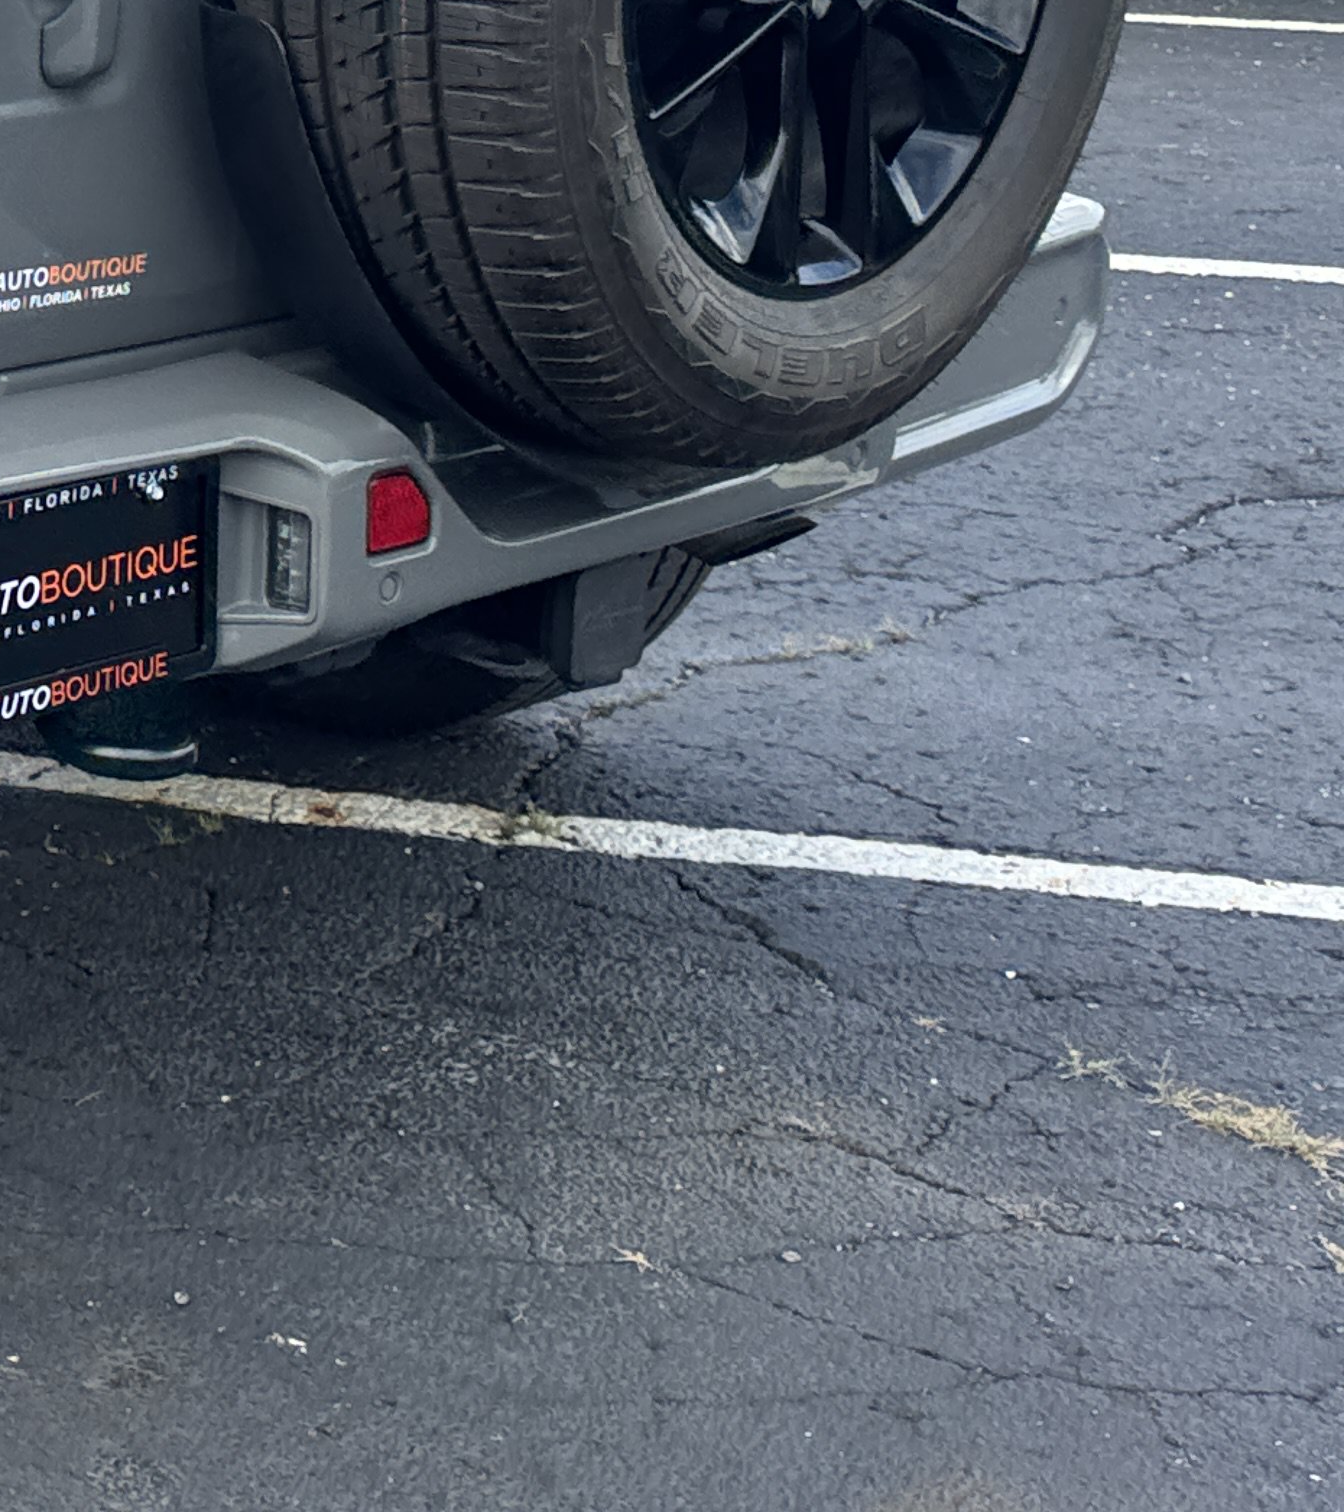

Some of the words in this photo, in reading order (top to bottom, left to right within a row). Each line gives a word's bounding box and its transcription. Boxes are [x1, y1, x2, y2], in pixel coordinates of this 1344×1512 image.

[28, 289, 82, 310] FLORIDA
[91, 282, 131, 301] TEXAS
[655, 245, 928, 387] DUELER
[23, 482, 103, 514] FLORIDA
[128, 465, 178, 489] TEXAS
[4, 605, 96, 639] FLORIDA
[126, 581, 190, 608] TEXAS
